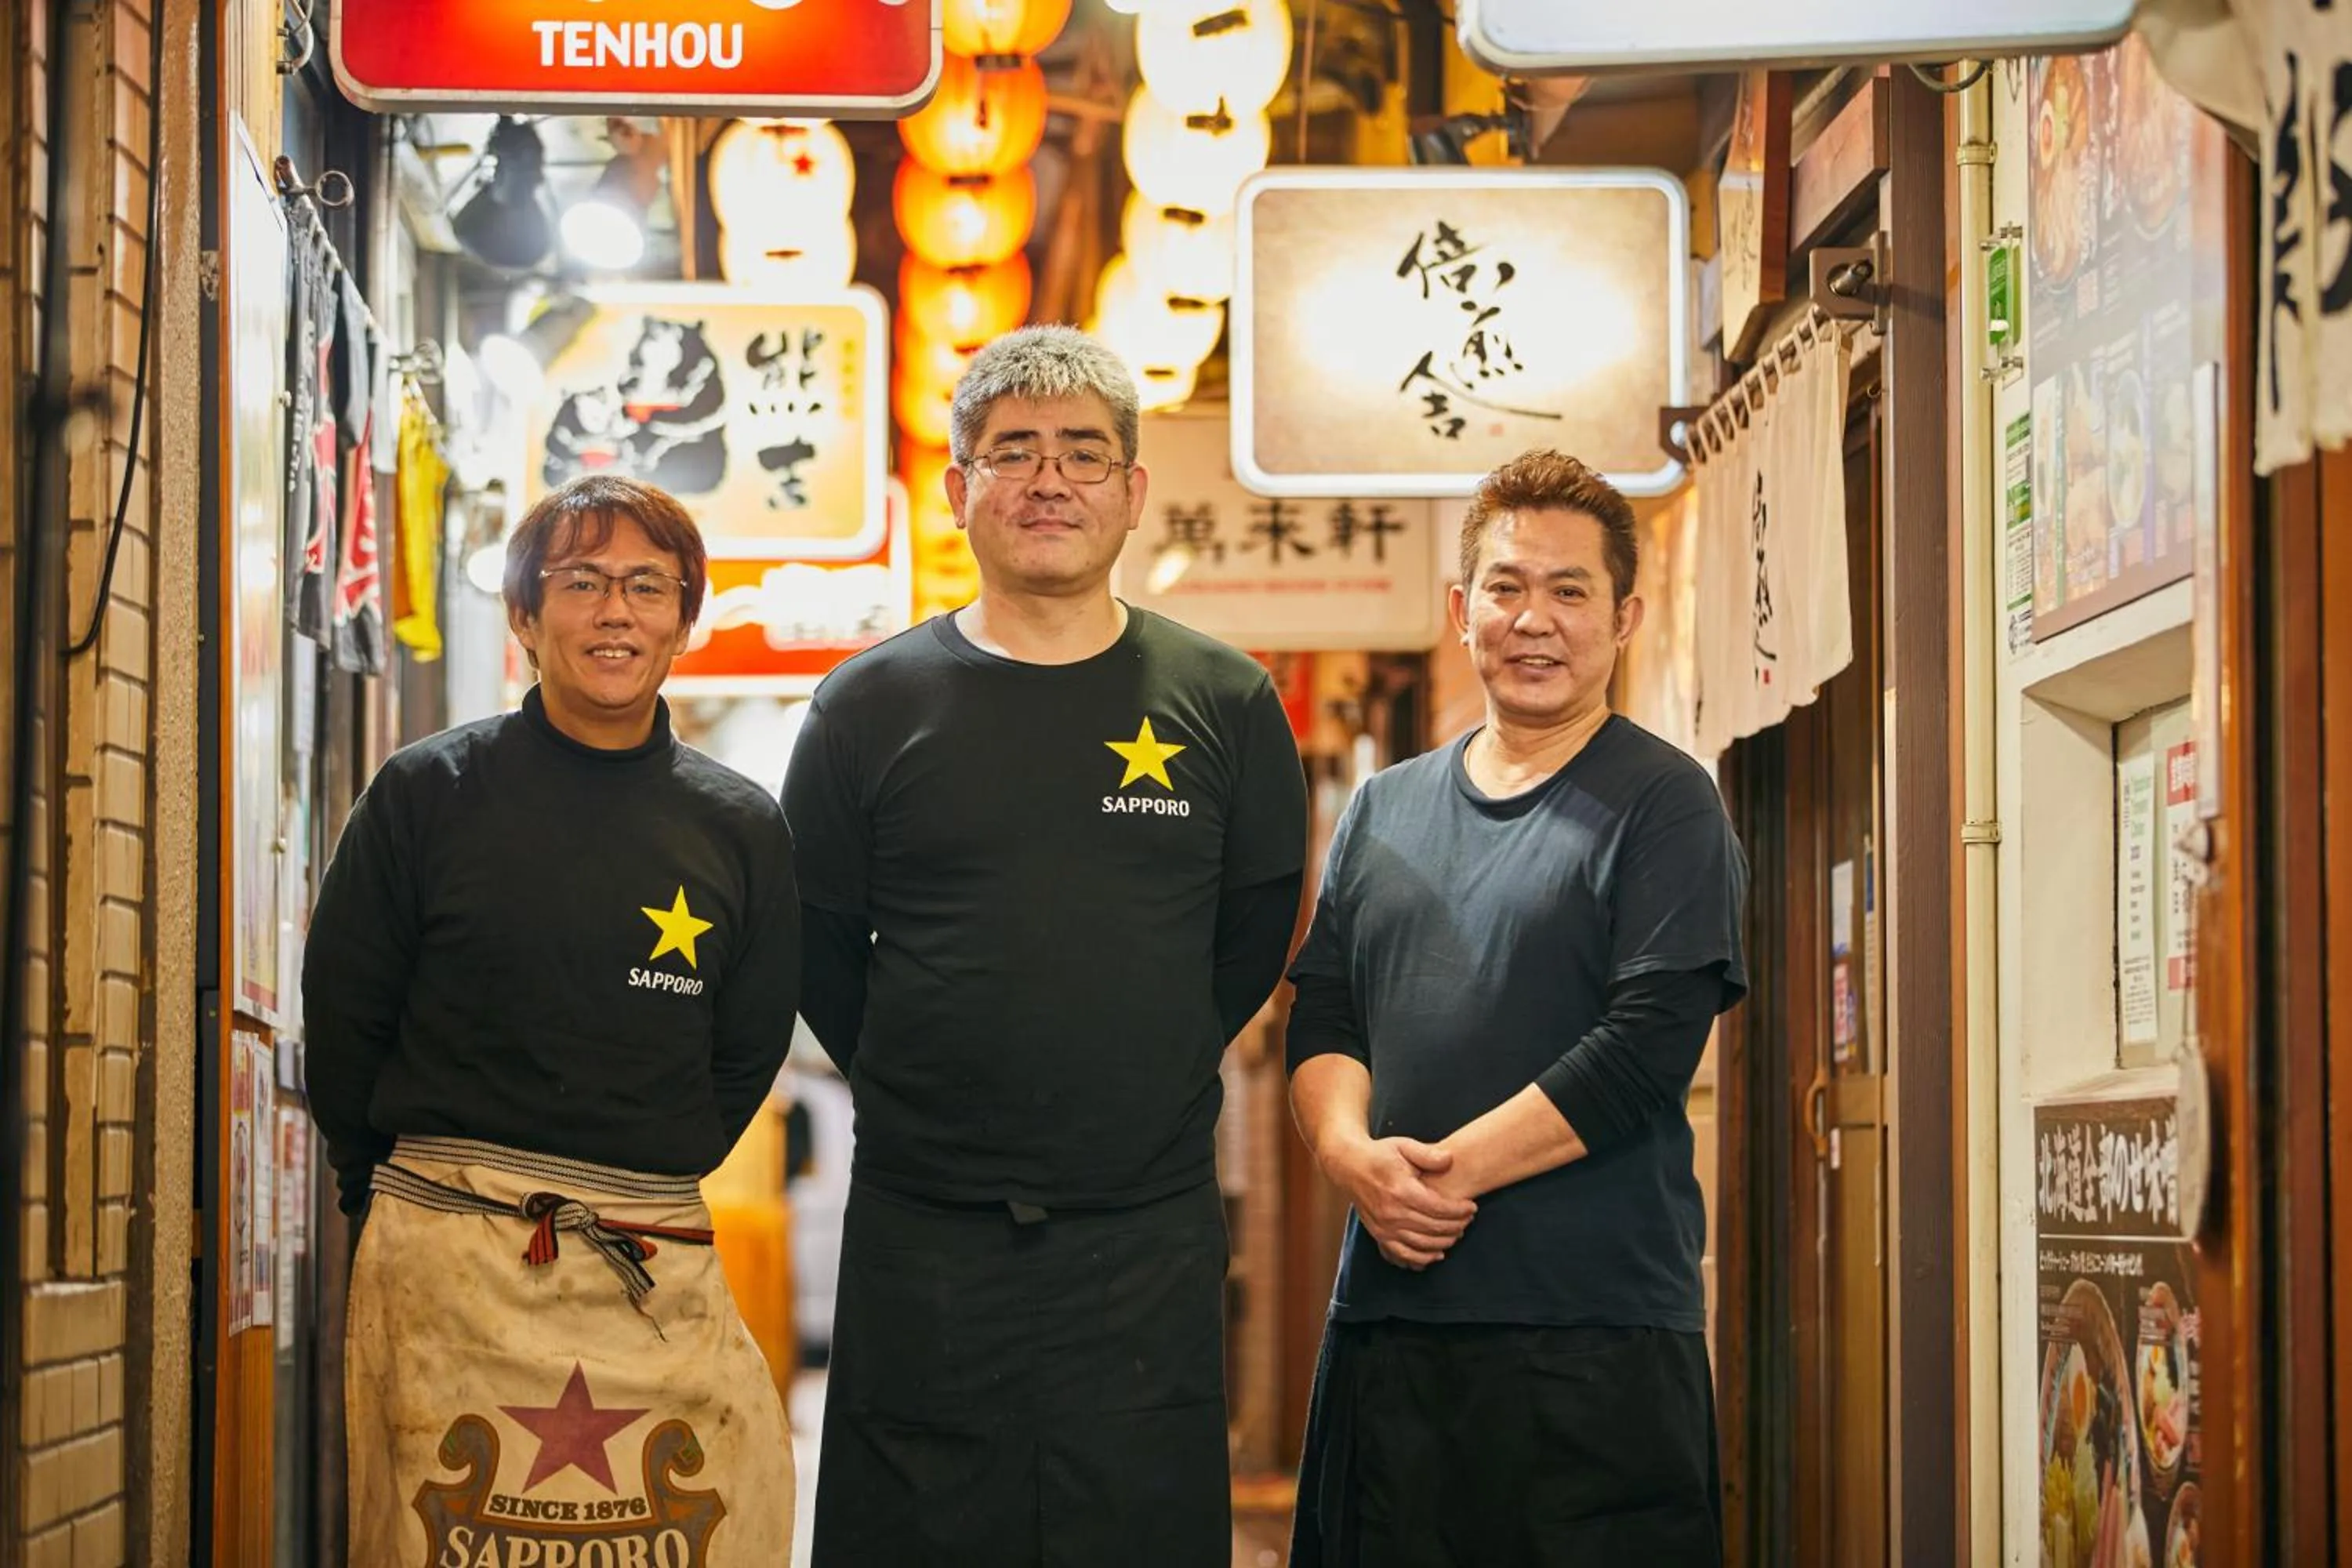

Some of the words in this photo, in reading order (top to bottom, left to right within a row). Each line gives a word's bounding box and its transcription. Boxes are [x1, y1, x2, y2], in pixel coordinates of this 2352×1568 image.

[532, 20, 744, 69] TENHOU
[1102, 795, 1190, 817] SAPPORO
[628, 967, 703, 996] SAPPORO
[488, 1494, 579, 1521] SINCE
[583, 1497, 648, 1520] 1876
[439, 1525, 690, 1568] SAPPORO
